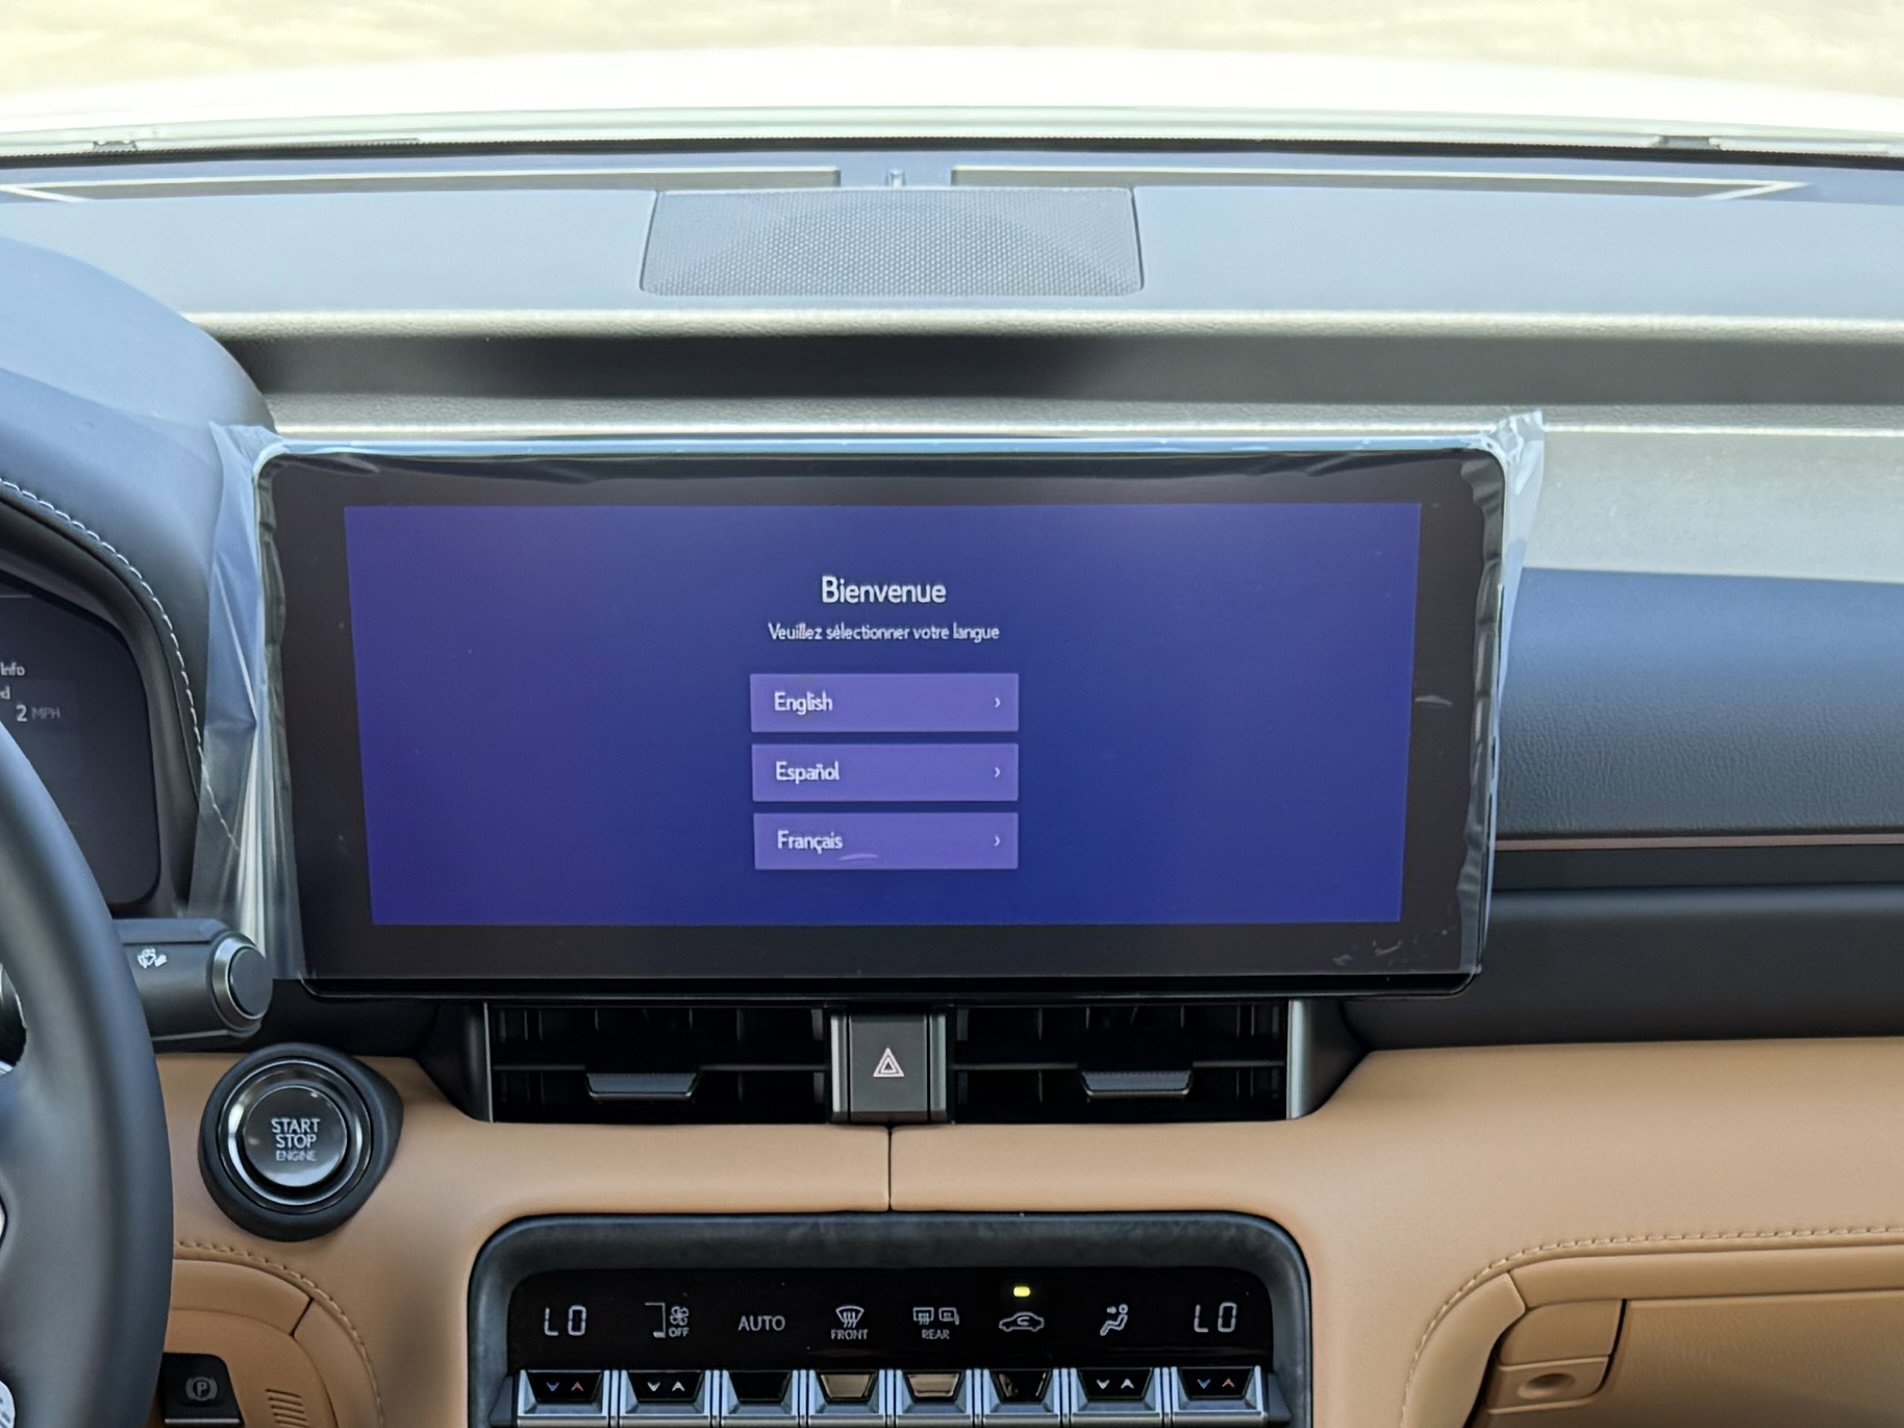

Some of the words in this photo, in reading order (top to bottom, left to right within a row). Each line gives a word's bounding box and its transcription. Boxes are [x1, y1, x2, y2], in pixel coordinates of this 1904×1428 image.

[821, 574, 947, 604] Bienvenue
[768, 622, 823, 641] Veuillez
[912, 624, 950, 640] votre
[953, 622, 1000, 643] langue
[0, 662, 25, 677] Info
[774, 691, 833, 715] English
[15, 704, 28, 722] 2
[775, 760, 841, 784] Español
[777, 830, 843, 854] Français
[271, 1118, 320, 1133] START
[275, 1133, 317, 1149] STOP
[276, 1150, 317, 1161] ENGINE
[737, 1315, 786, 1332] AUTO
[669, 1328, 689, 1338] OFF
[830, 1329, 868, 1341] FRONT
[921, 1329, 950, 1340] REAR
